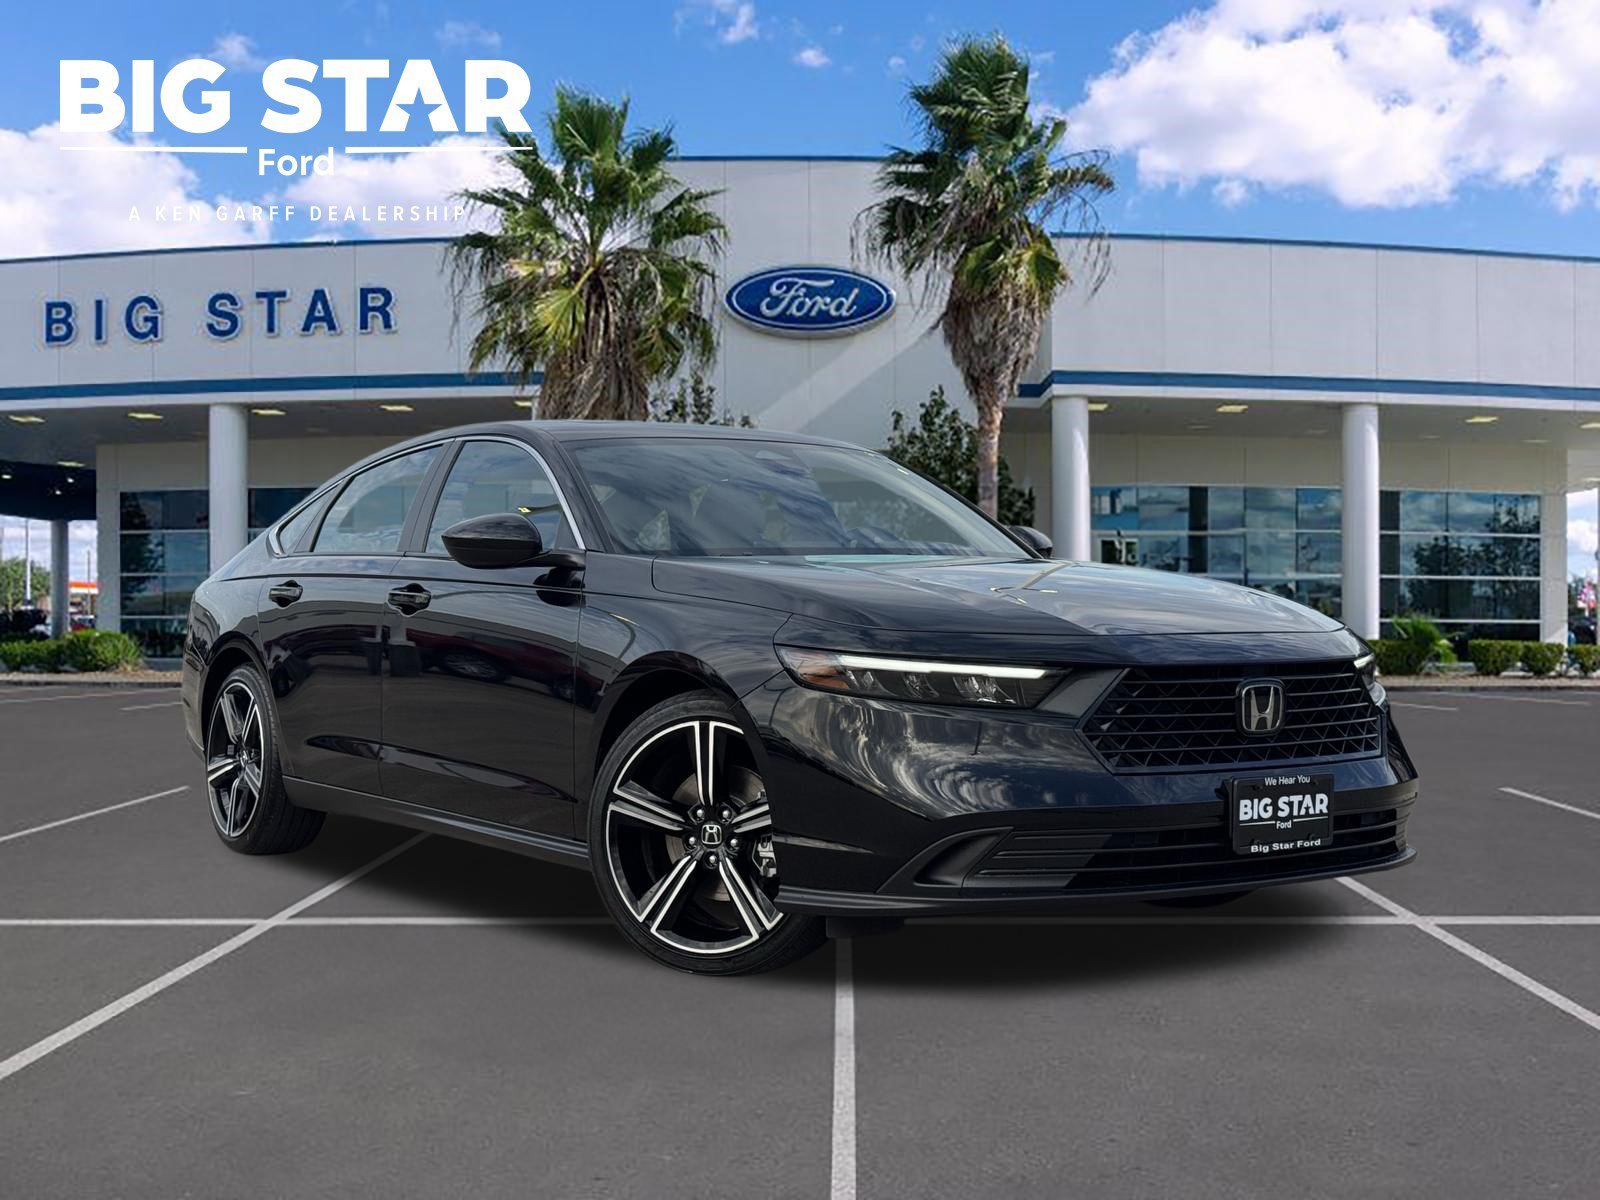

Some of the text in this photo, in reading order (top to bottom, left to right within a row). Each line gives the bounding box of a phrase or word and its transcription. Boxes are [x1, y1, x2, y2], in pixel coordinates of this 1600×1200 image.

[760, 277, 859, 317] Ford
[45, 287, 397, 344] BIG STAR
[1264, 774, 1311, 786] We Hear You
[1239, 793, 1329, 821] BIG STAR
[1276, 820, 1292, 829] Ford
[1250, 838, 1321, 853] Big Star Ford
